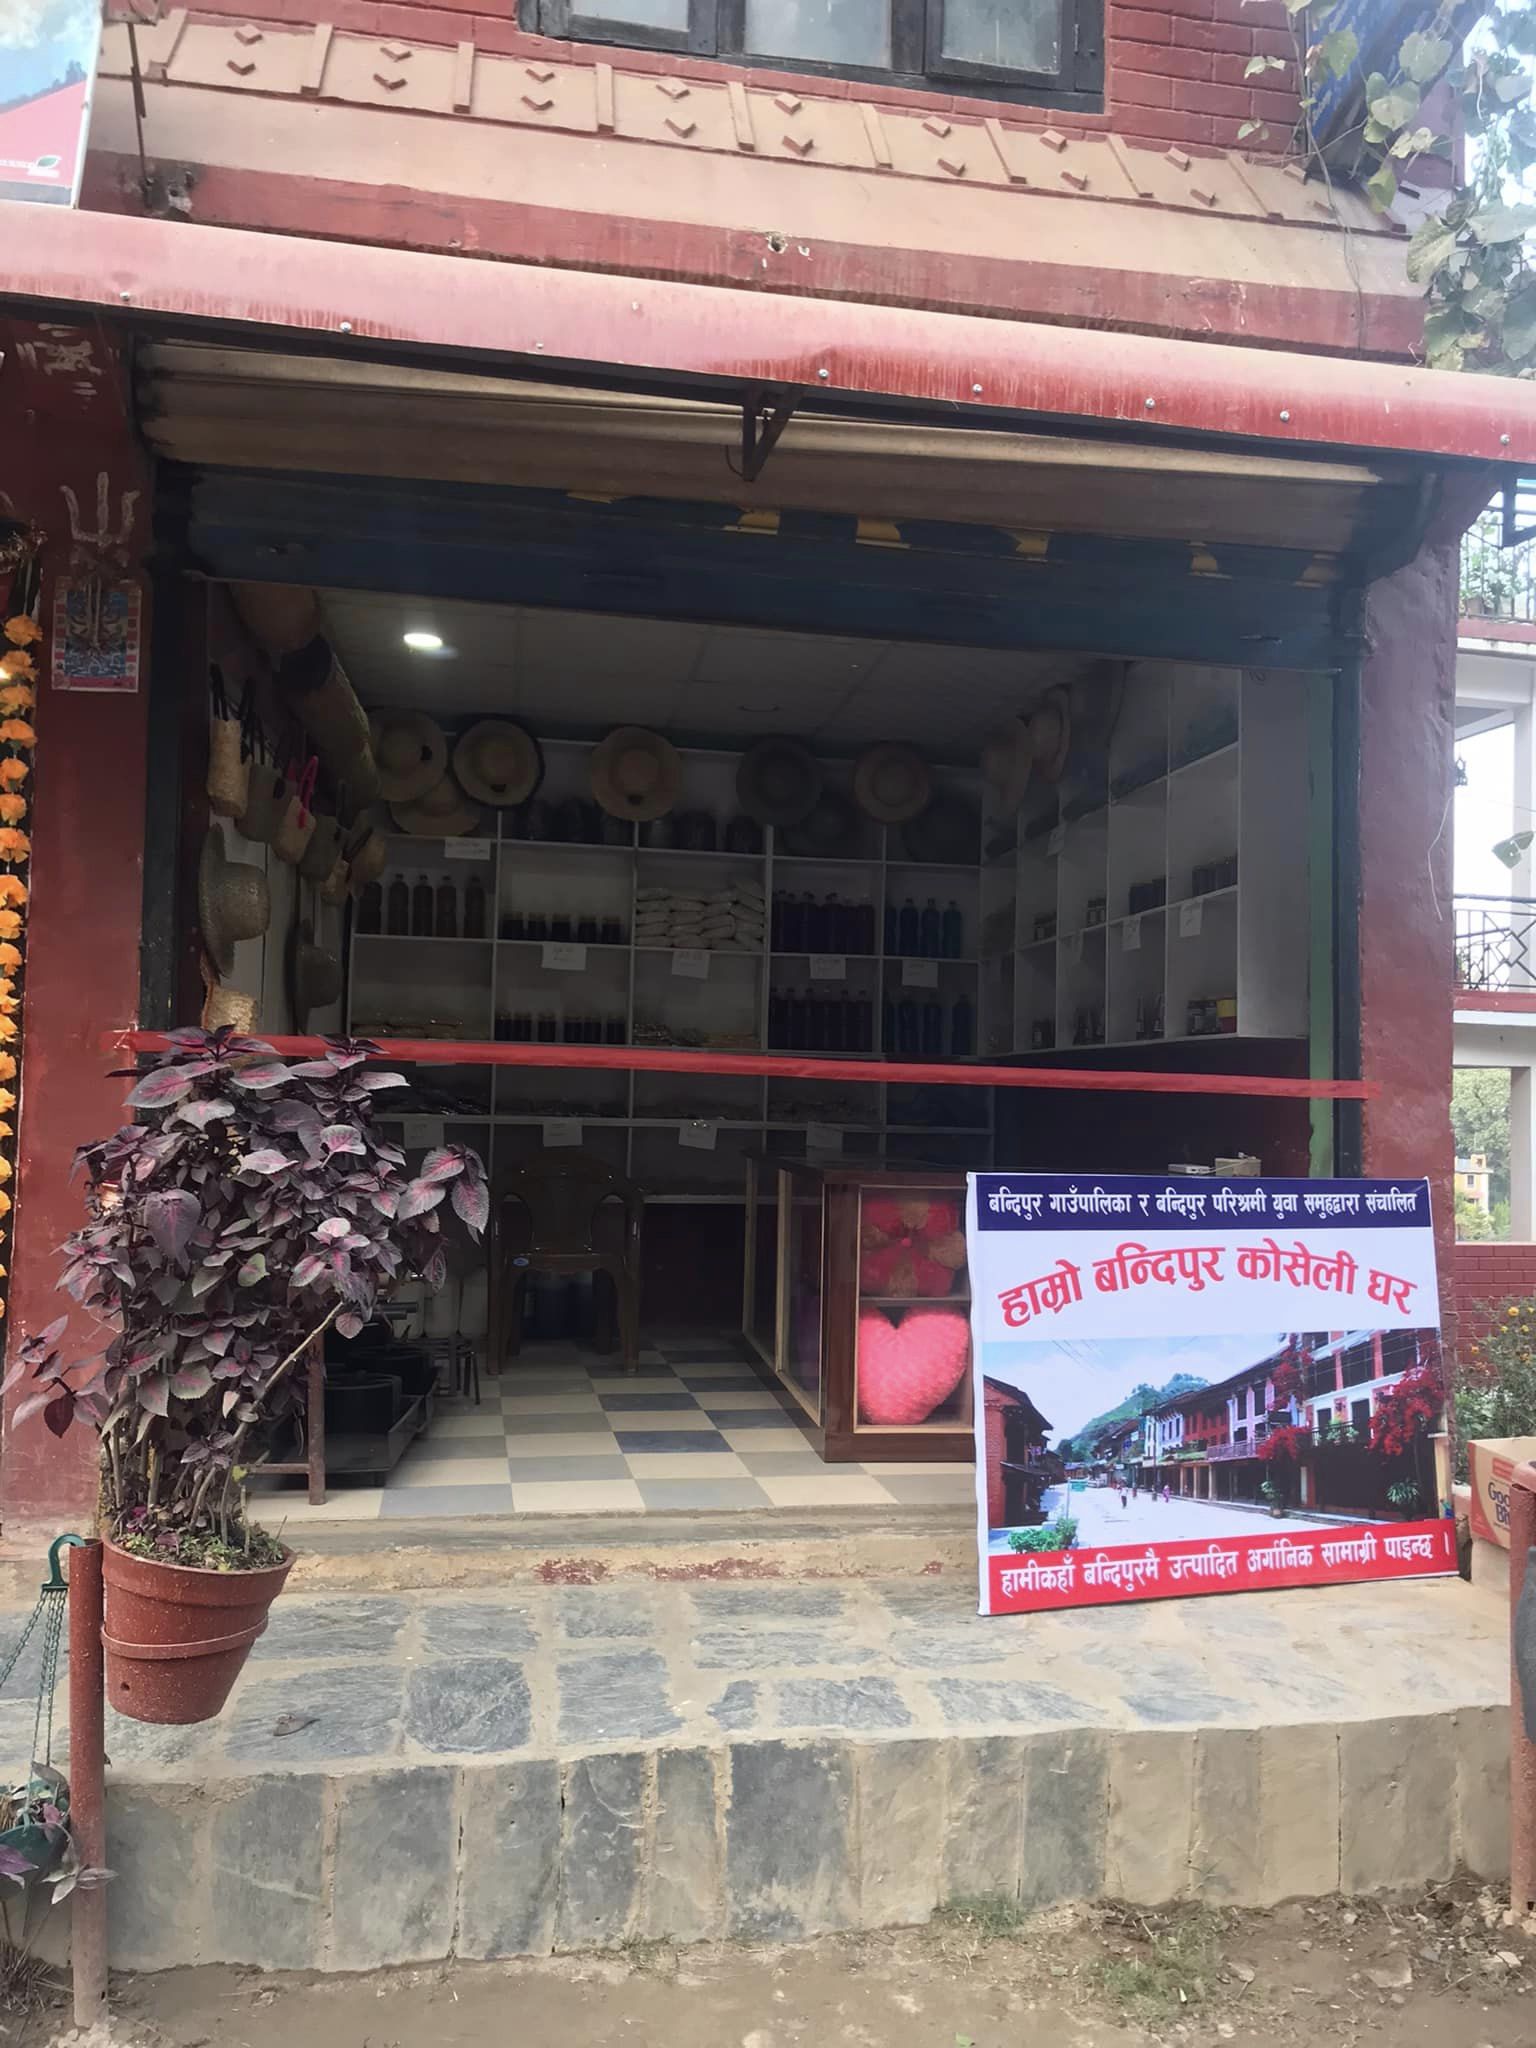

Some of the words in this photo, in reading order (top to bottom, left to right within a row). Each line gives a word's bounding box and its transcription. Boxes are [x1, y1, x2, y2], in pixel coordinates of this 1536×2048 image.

[988, 1186, 1043, 1220] बन्दिपुर
[1049, 1184, 1132, 1215] गाउँपालिका
[1138, 1194, 1149, 1216] र
[1155, 1187, 1207, 1220] बन्दिपुर
[1212, 1187, 1267, 1217] परिश्रमी
[1272, 1193, 1298, 1219] युवा
[1304, 1193, 1360, 1219] समुहद्वारा
[1365, 1187, 1417, 1214] संचालित
[998, 1259, 1083, 1327] हाम्रो
[1092, 1242, 1226, 1292] बन्दिपुर
[1236, 1237, 1358, 1294] कोसेली
[1367, 1268, 1418, 1315] घर
[1000, 1554, 1076, 1598] हामीकहाँ
[1082, 1547, 1160, 1592] बन्दिपुरमै
[1168, 1544, 1239, 1579] उत्पादित
[1247, 1537, 1314, 1573] अर्गानिक
[1321, 1531, 1377, 1567] सामाग्री
[1383, 1534, 1433, 1560] पाइन्छ
